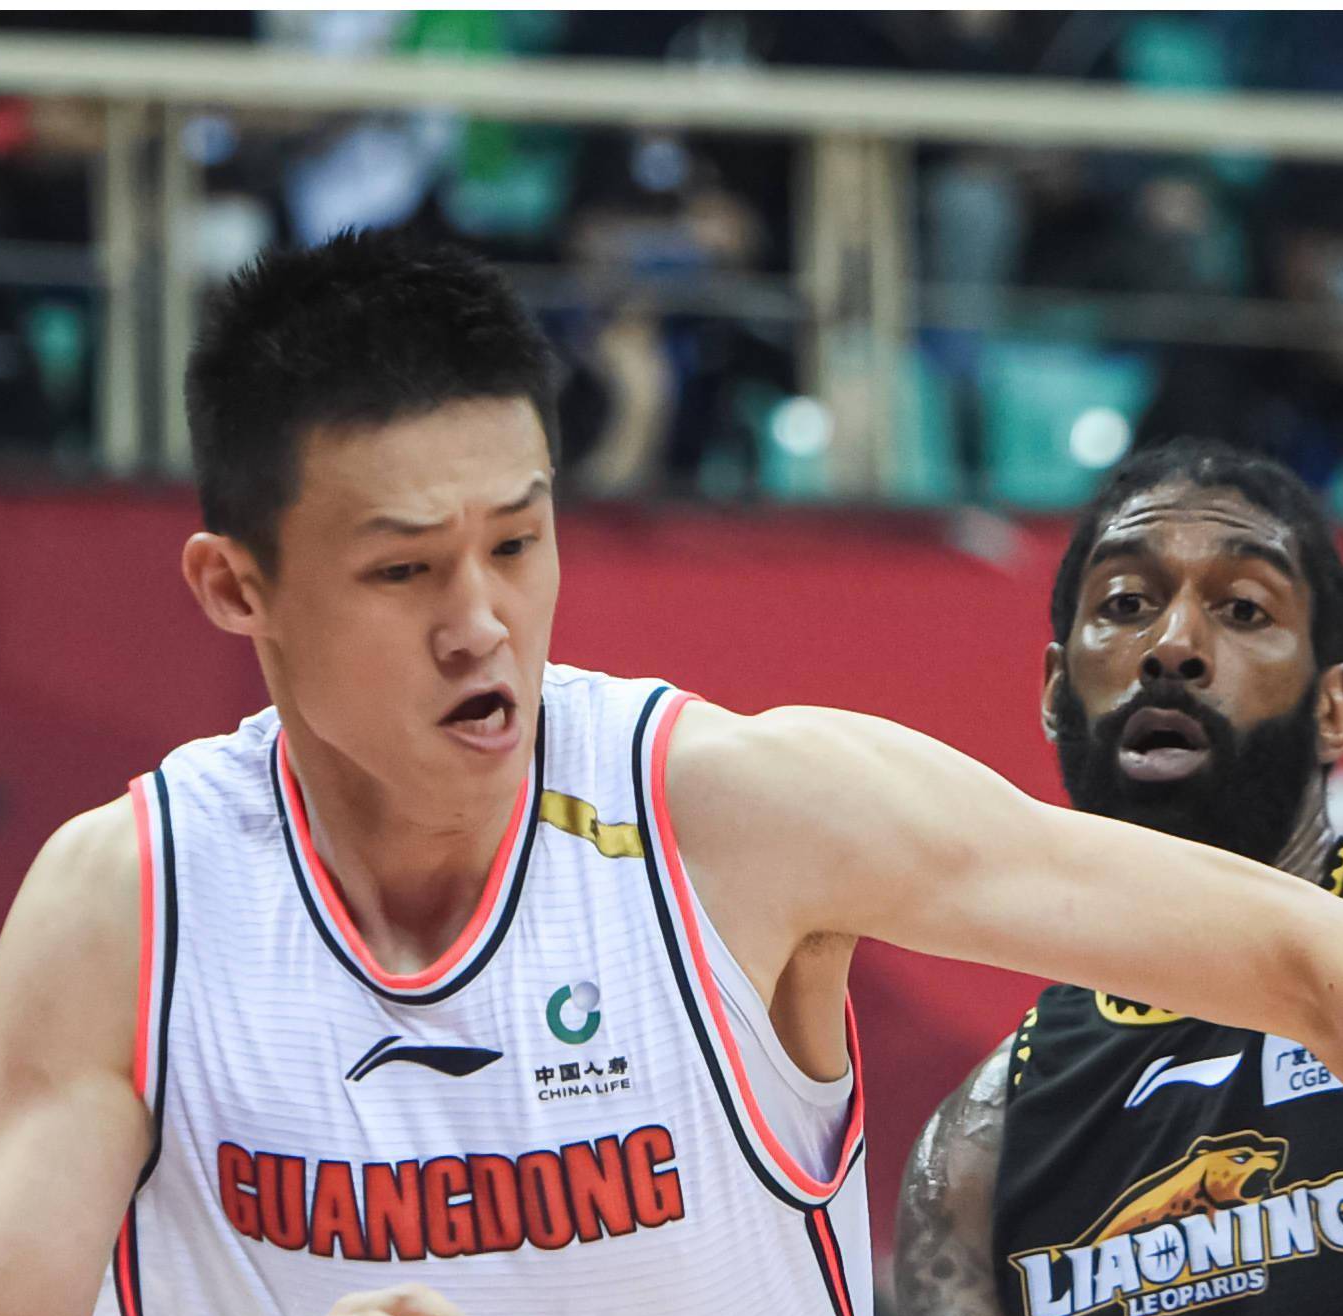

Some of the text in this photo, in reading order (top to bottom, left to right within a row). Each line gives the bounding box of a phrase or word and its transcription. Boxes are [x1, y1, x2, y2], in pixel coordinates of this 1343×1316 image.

[534, 1055, 628, 1087] 中国人寿
[1289, 1066, 1331, 1091] CGB
[538, 1077, 631, 1101] CHINA LIFE
[217, 1124, 685, 1262] GUANGDONG
